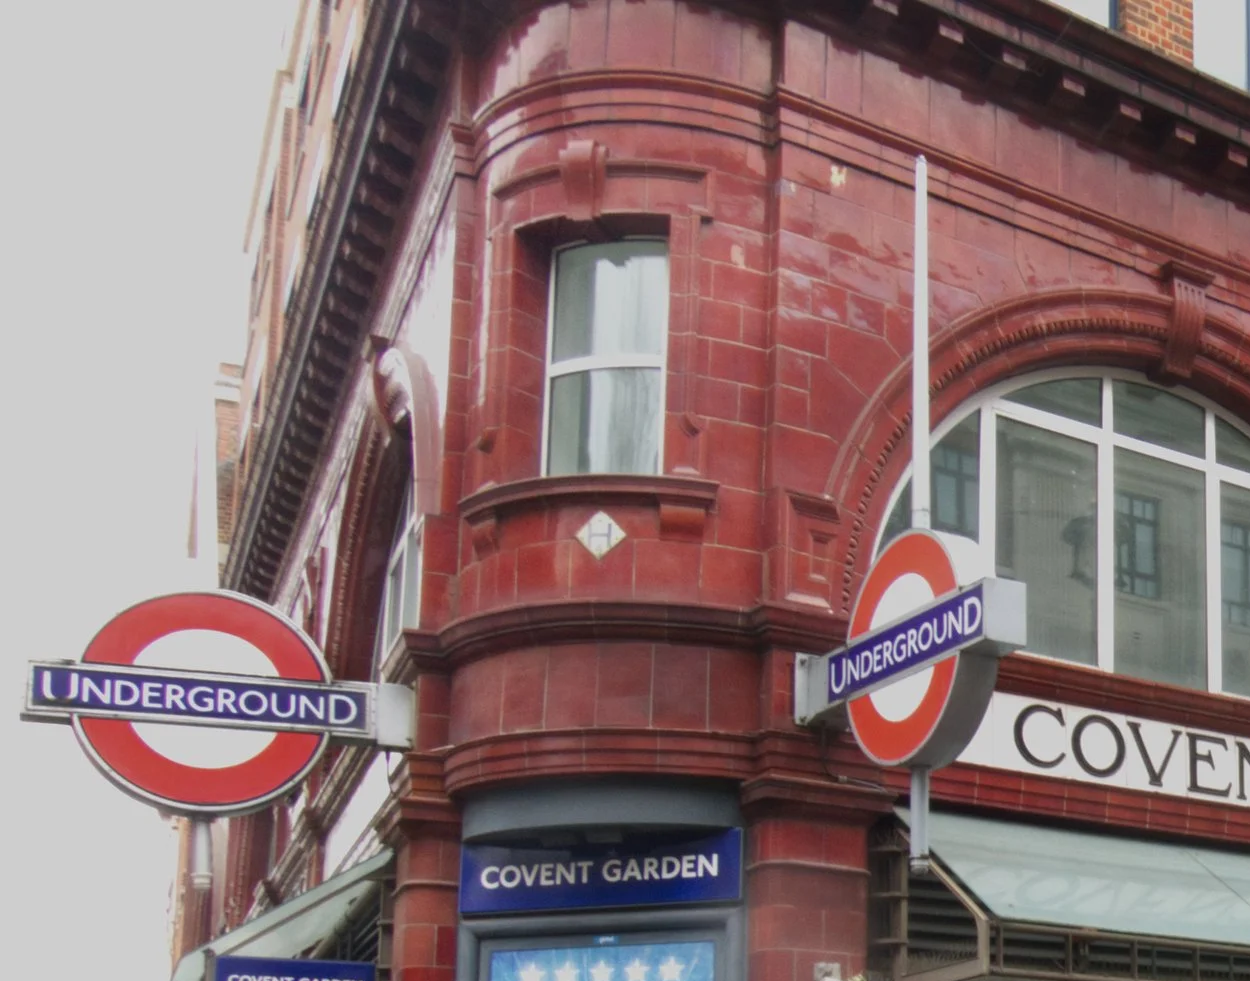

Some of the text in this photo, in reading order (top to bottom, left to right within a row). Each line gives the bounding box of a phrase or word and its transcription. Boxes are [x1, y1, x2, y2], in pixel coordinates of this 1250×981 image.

[831, 596, 982, 694] UNDERGROUND
[41, 670, 358, 725] UNDERGROUND
[480, 853, 719, 889] COVENT GARDEN
